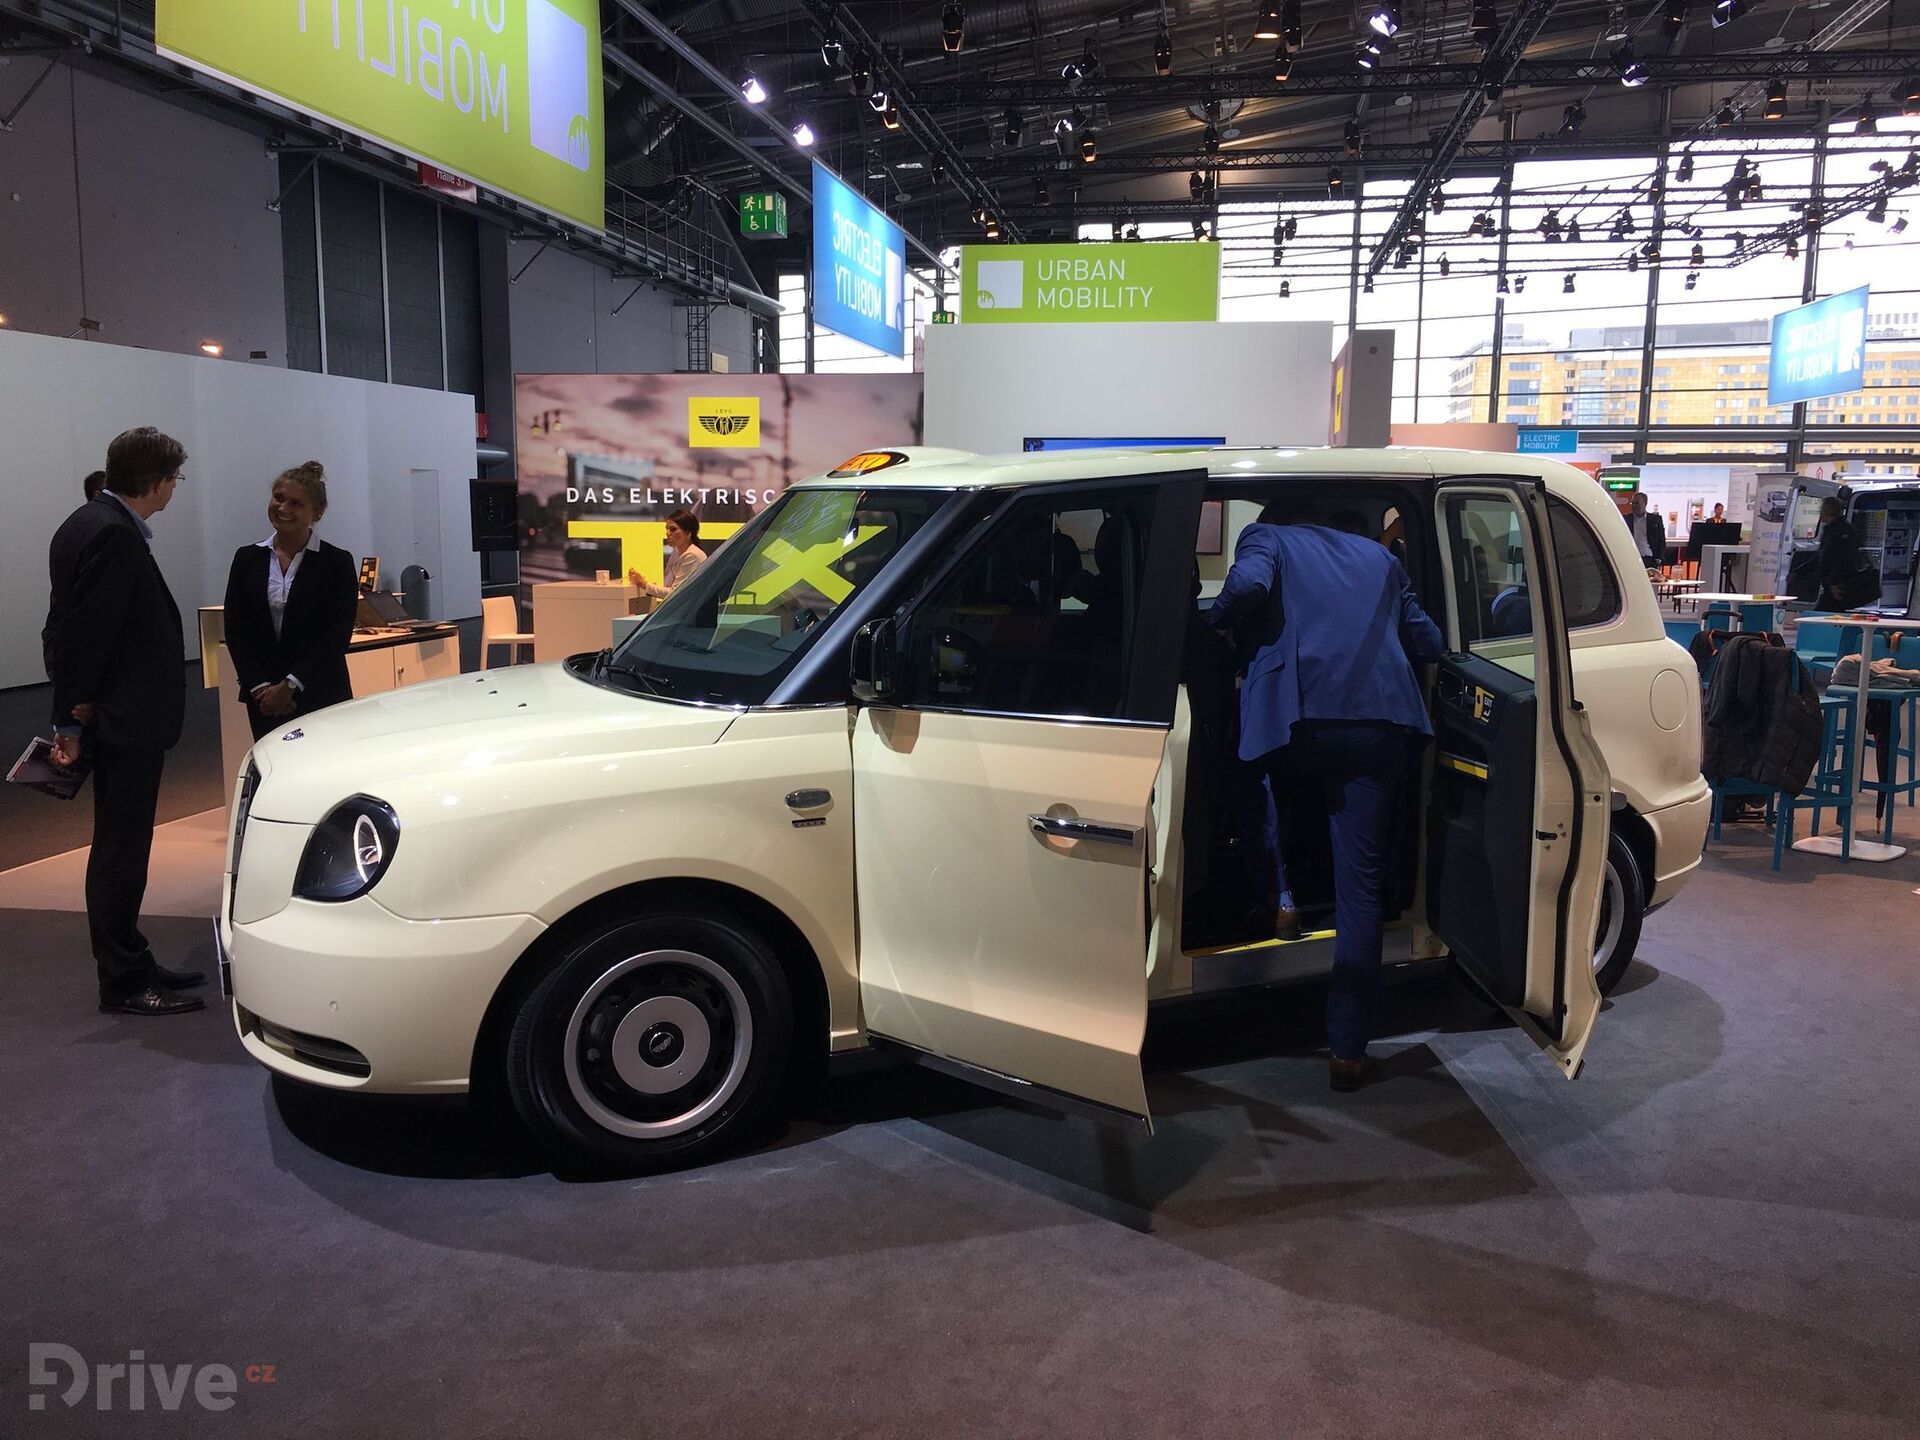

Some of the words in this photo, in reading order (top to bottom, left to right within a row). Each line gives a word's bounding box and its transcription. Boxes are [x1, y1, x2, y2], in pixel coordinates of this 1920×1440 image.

[1038, 259, 1125, 281] URBAN
[1038, 287, 1154, 308] MOBILITY
[1523, 442, 1559, 450] MOBILITY
[1524, 434, 1561, 442] ELECTRIC
[567, 487, 615, 504] DAS
